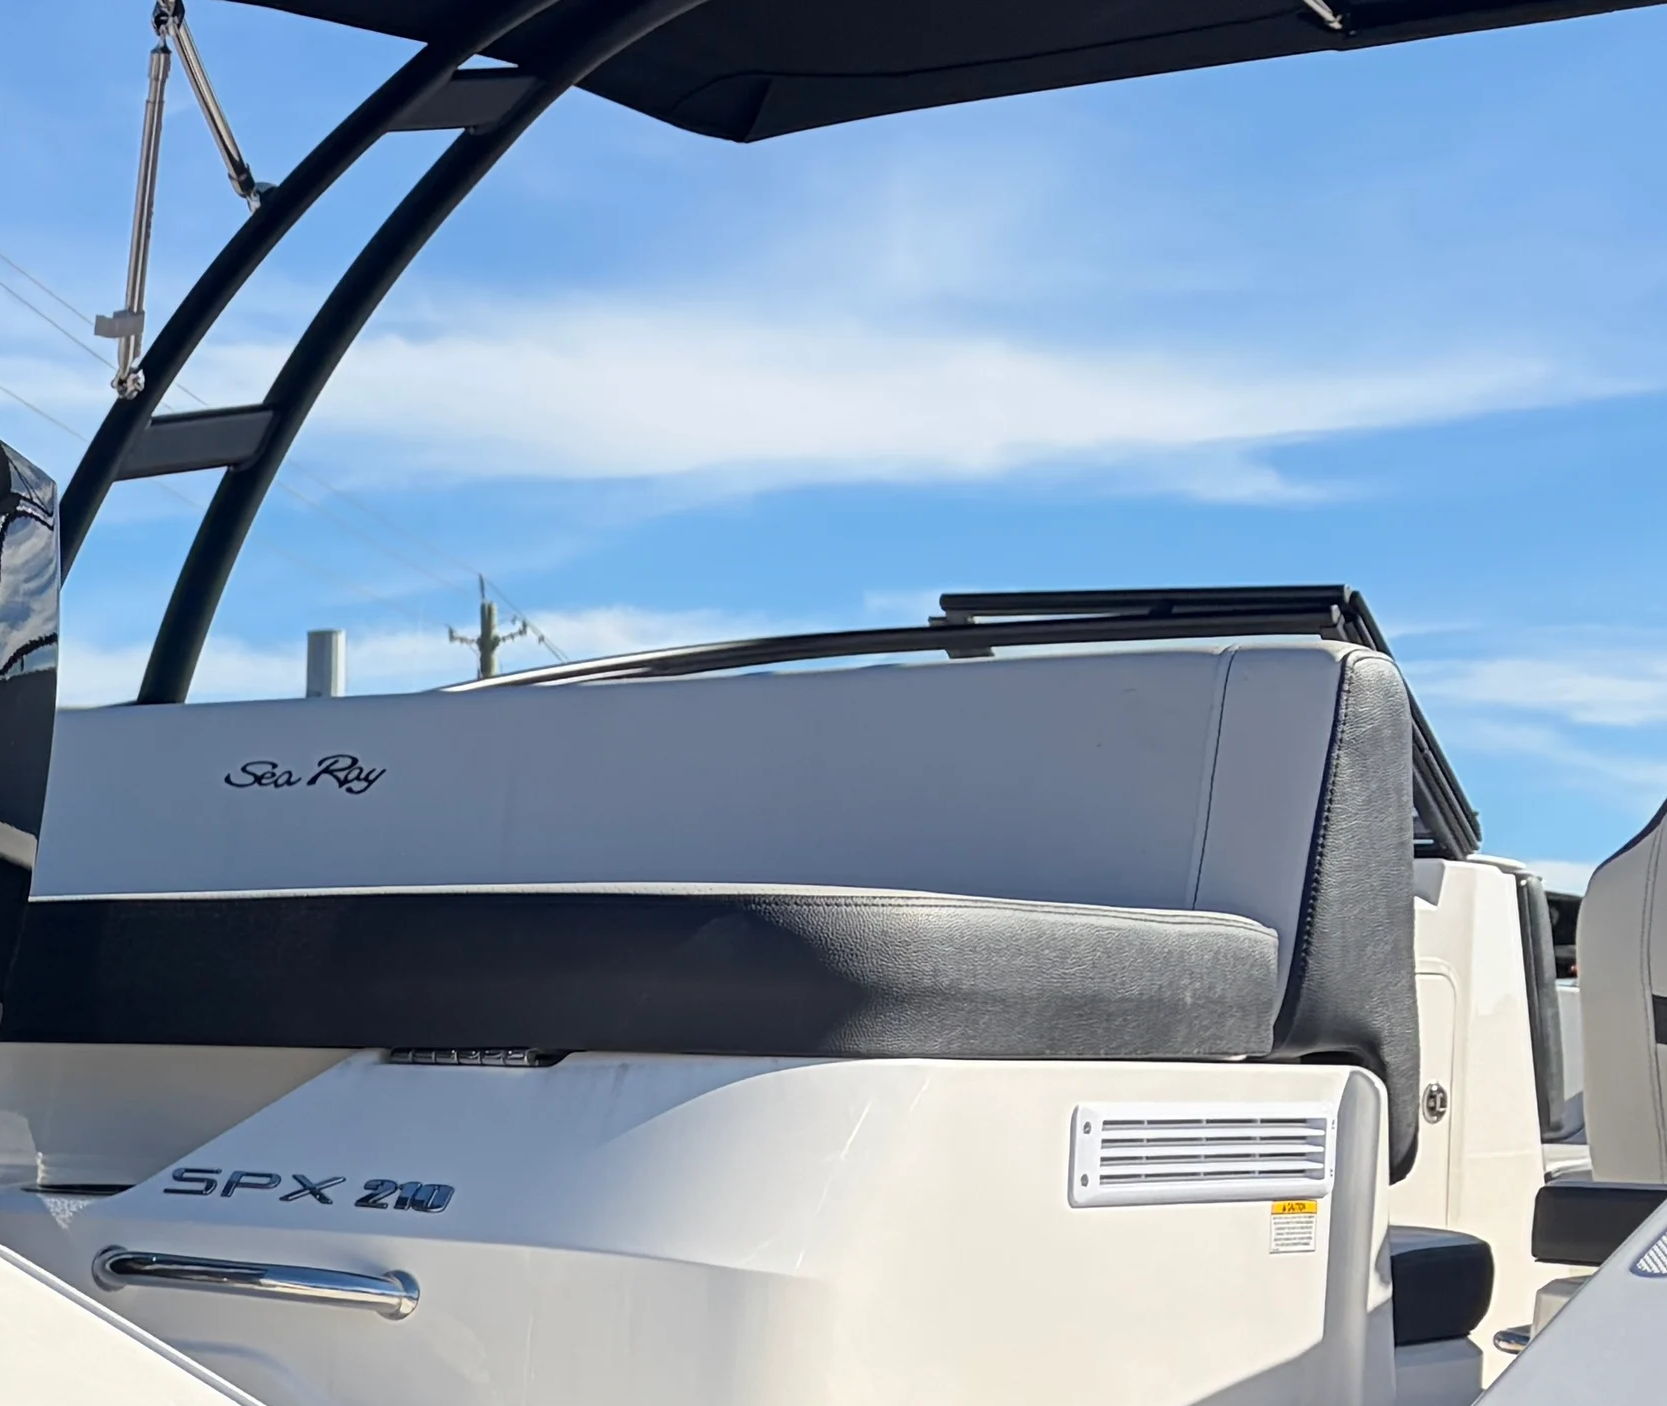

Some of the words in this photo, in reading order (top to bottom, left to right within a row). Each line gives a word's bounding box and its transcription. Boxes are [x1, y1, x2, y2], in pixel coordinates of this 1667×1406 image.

[224, 760, 302, 788] Sea
[306, 754, 387, 795] Ray
[163, 1167, 346, 1205] SPX
[354, 1178, 456, 1214] 210
